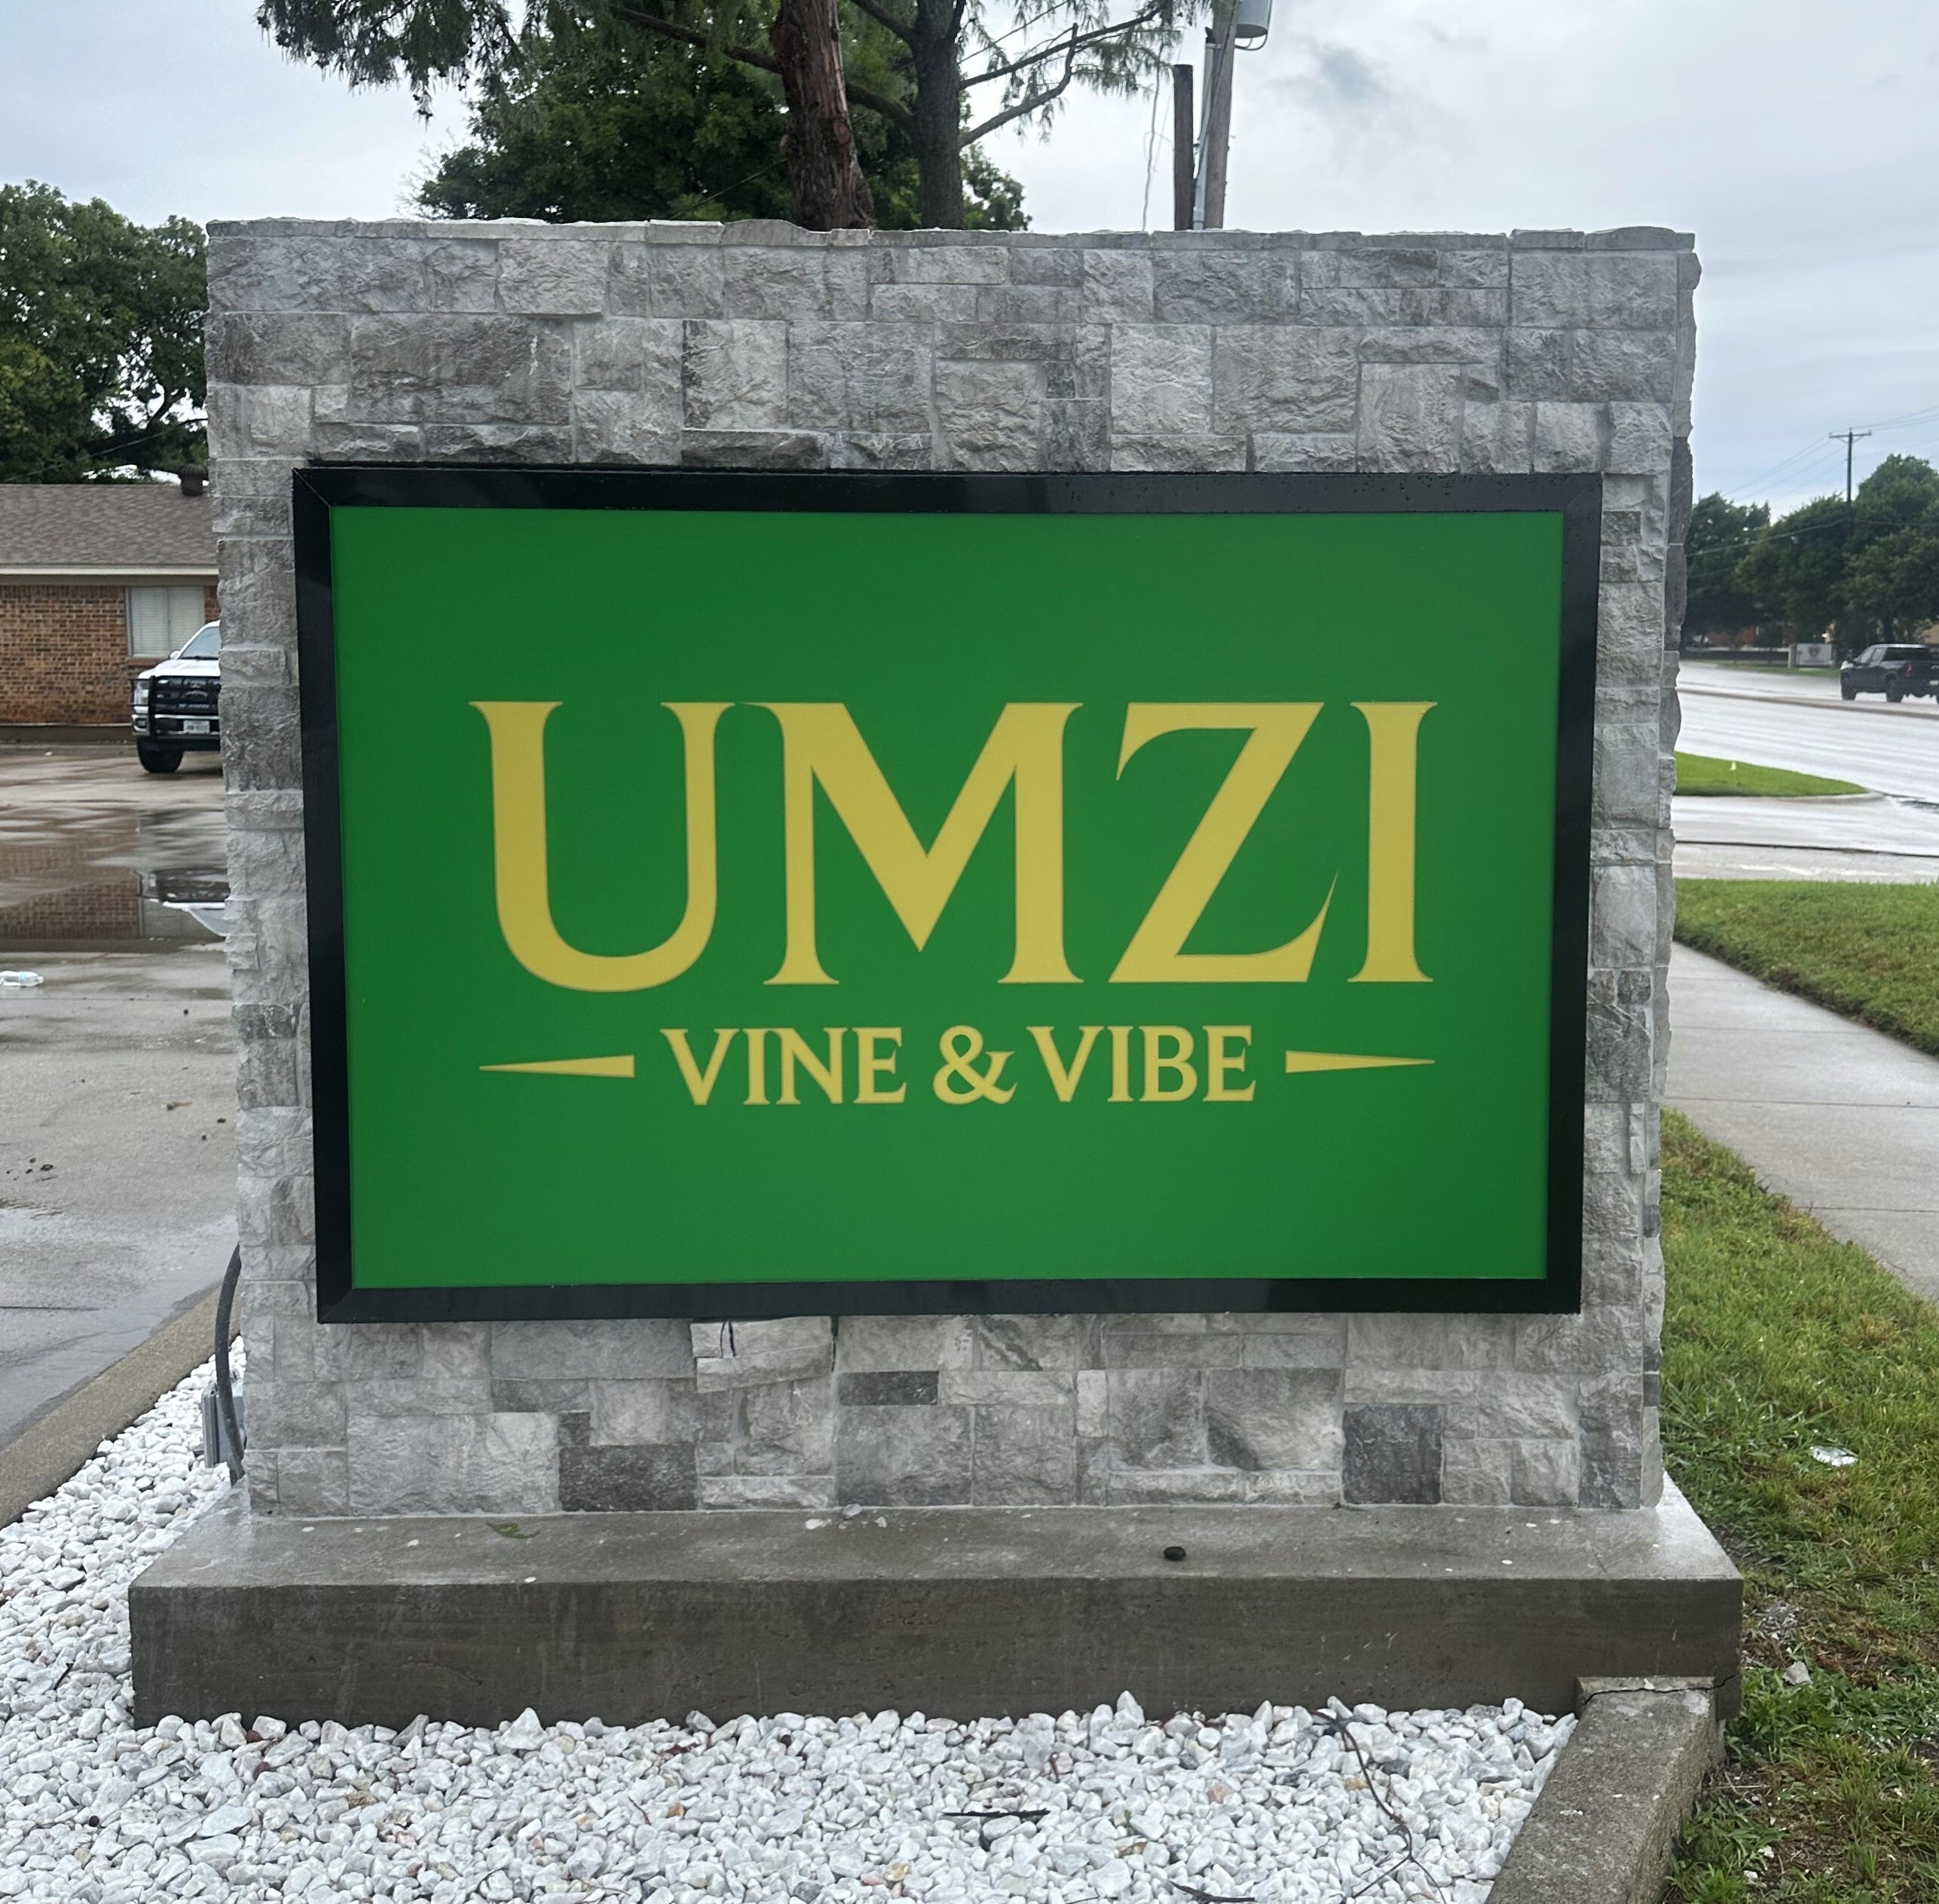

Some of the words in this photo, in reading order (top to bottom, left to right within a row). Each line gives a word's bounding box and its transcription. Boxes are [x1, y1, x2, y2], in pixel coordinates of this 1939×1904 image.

[469, 699, 1437, 993] UMZI
[661, 1027, 907, 1106] VINE
[932, 1024, 1017, 1105] &
[1027, 1024, 1257, 1104] VIBE
